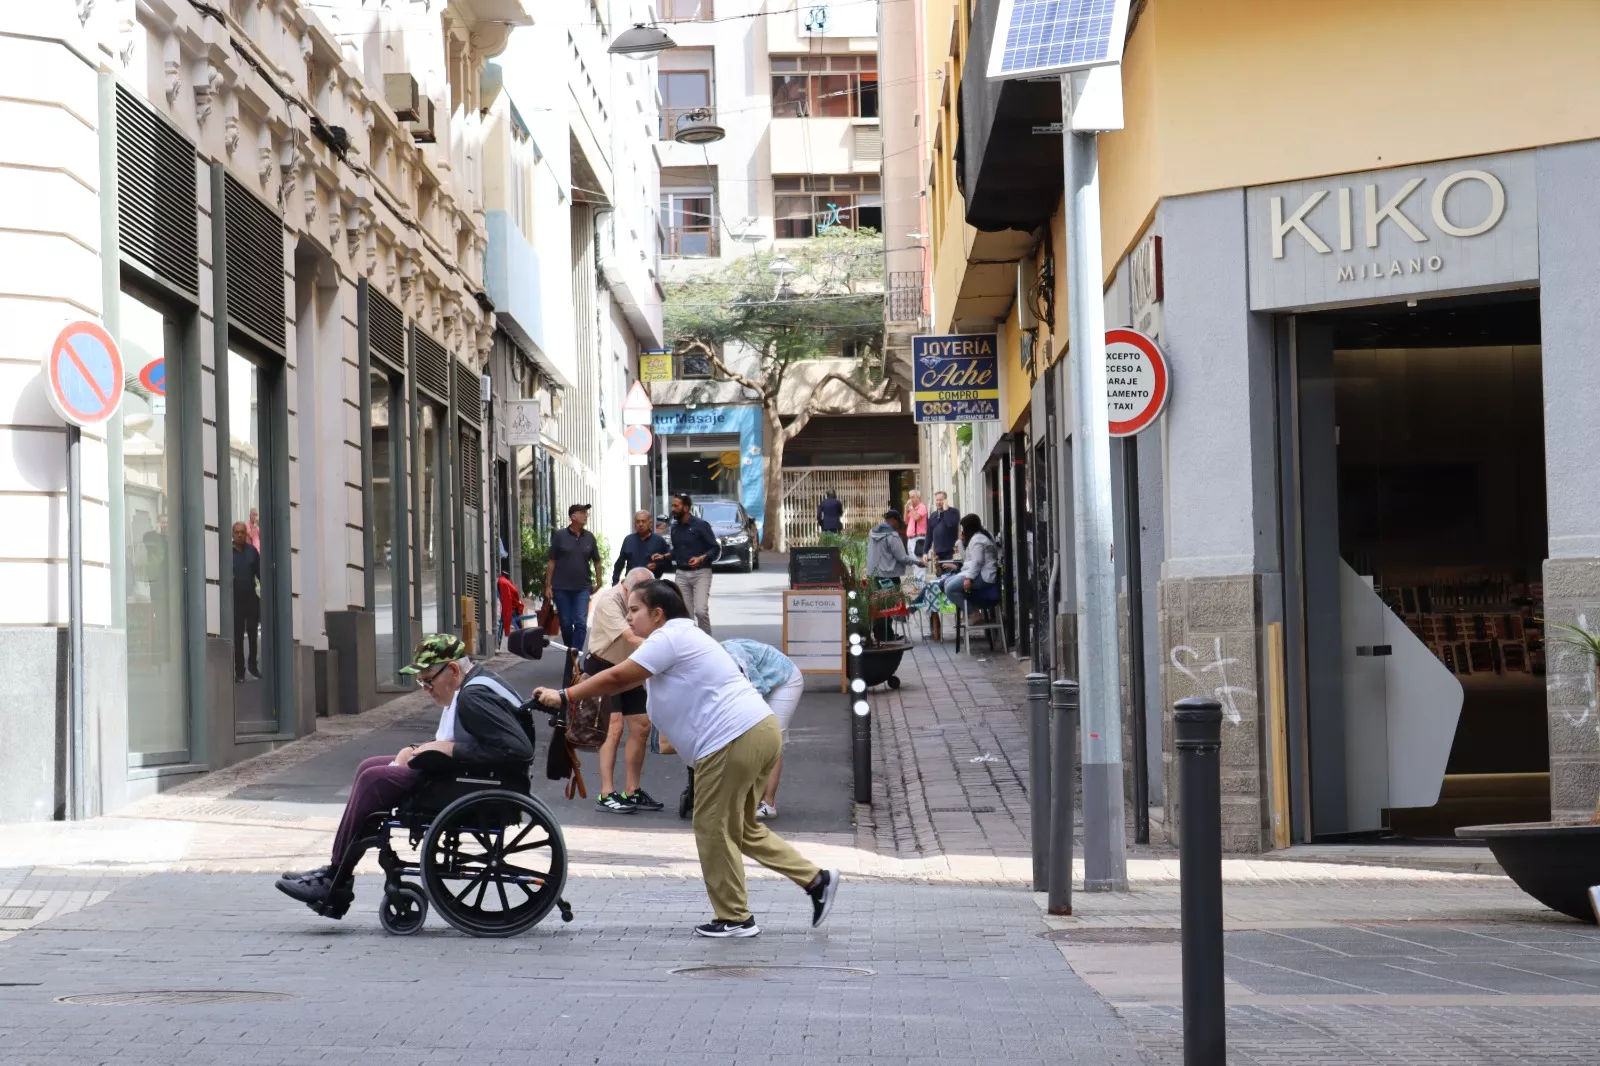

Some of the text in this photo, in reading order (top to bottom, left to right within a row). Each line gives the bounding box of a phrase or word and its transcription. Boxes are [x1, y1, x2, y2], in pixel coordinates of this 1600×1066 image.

[1270, 169, 1507, 259] KIKO
[1337, 255, 1444, 282] MILANO
[920, 337, 992, 356] JOYERÍA
[1106, 352, 1140, 360] XCEPTO
[921, 360, 993, 388] Aché
[938, 390, 979, 400] COMPRO
[1107, 390, 1149, 398] LAMENTO
[922, 402, 952, 415] ORO
[957, 401, 994, 413] PLATA
[654, 412, 725, 425] turMasaje
